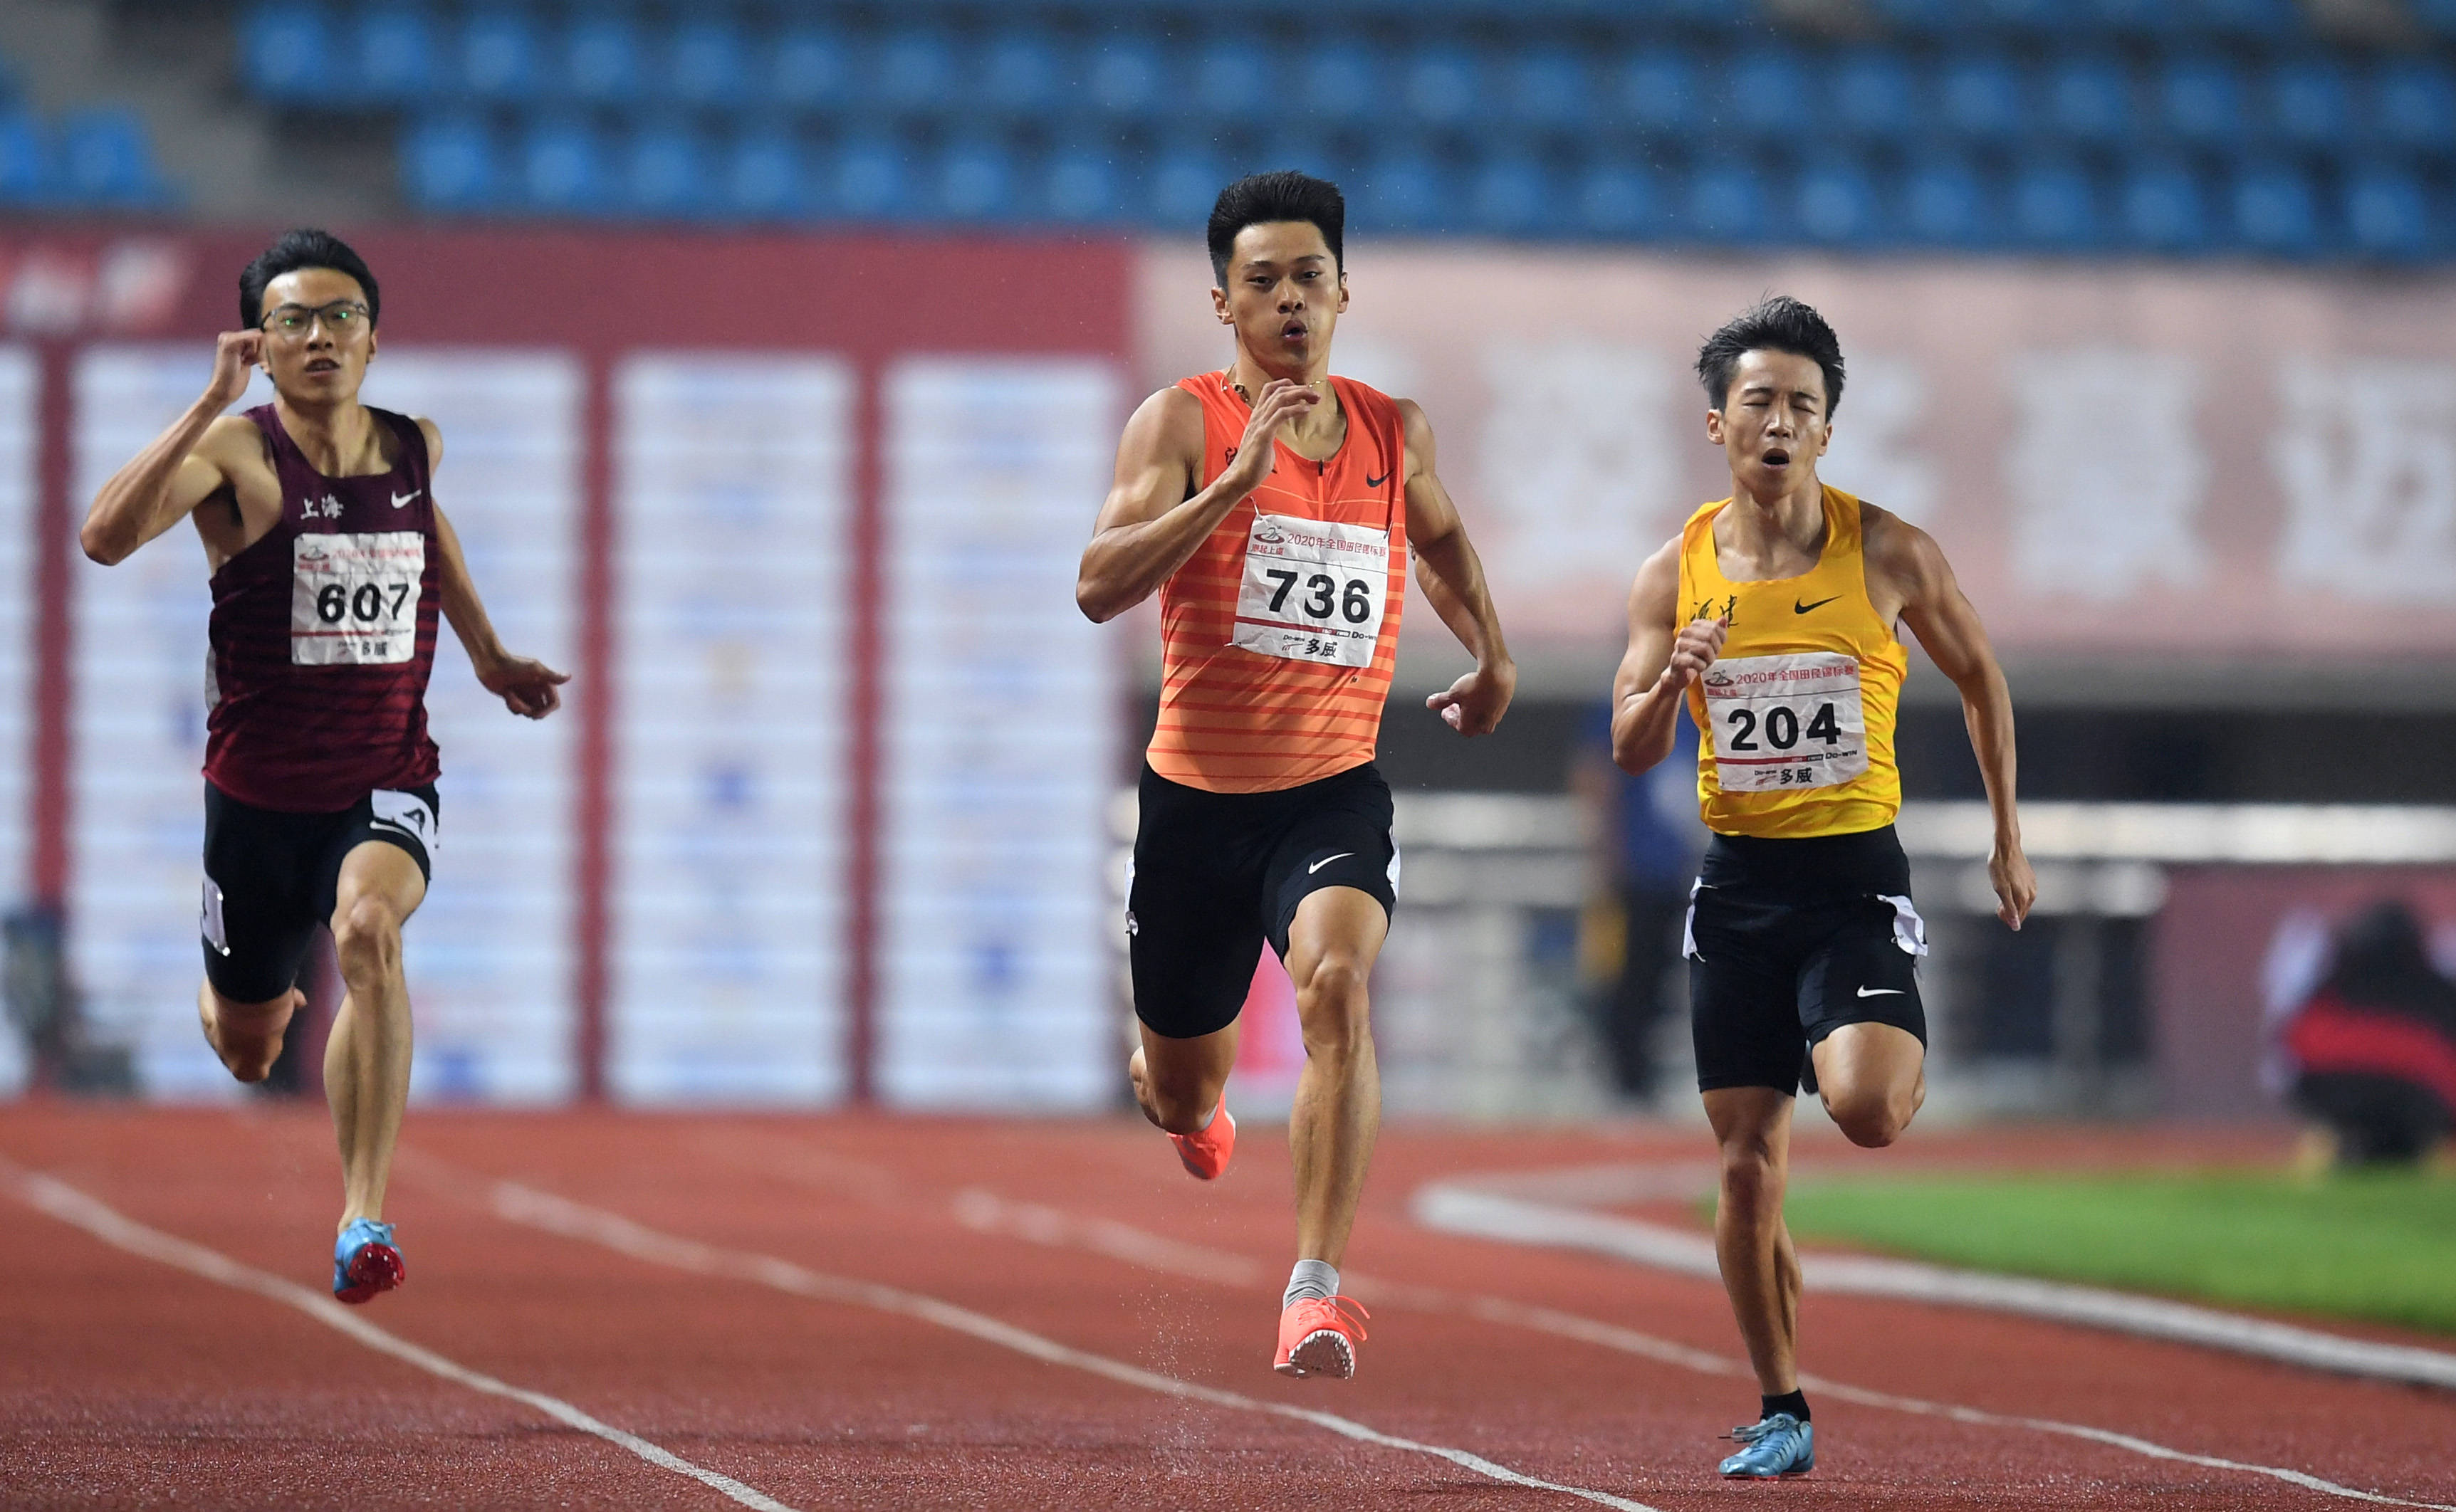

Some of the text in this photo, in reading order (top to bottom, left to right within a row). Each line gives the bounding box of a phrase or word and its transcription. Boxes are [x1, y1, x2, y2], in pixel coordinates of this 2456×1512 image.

[301, 493, 344, 520] 上海
[318, 582, 409, 623] 607
[1266, 569, 1370, 624] 736
[1305, 638, 1338, 658] 多威
[1728, 703, 1841, 750] 204
[1780, 767, 1812, 784] 多威
